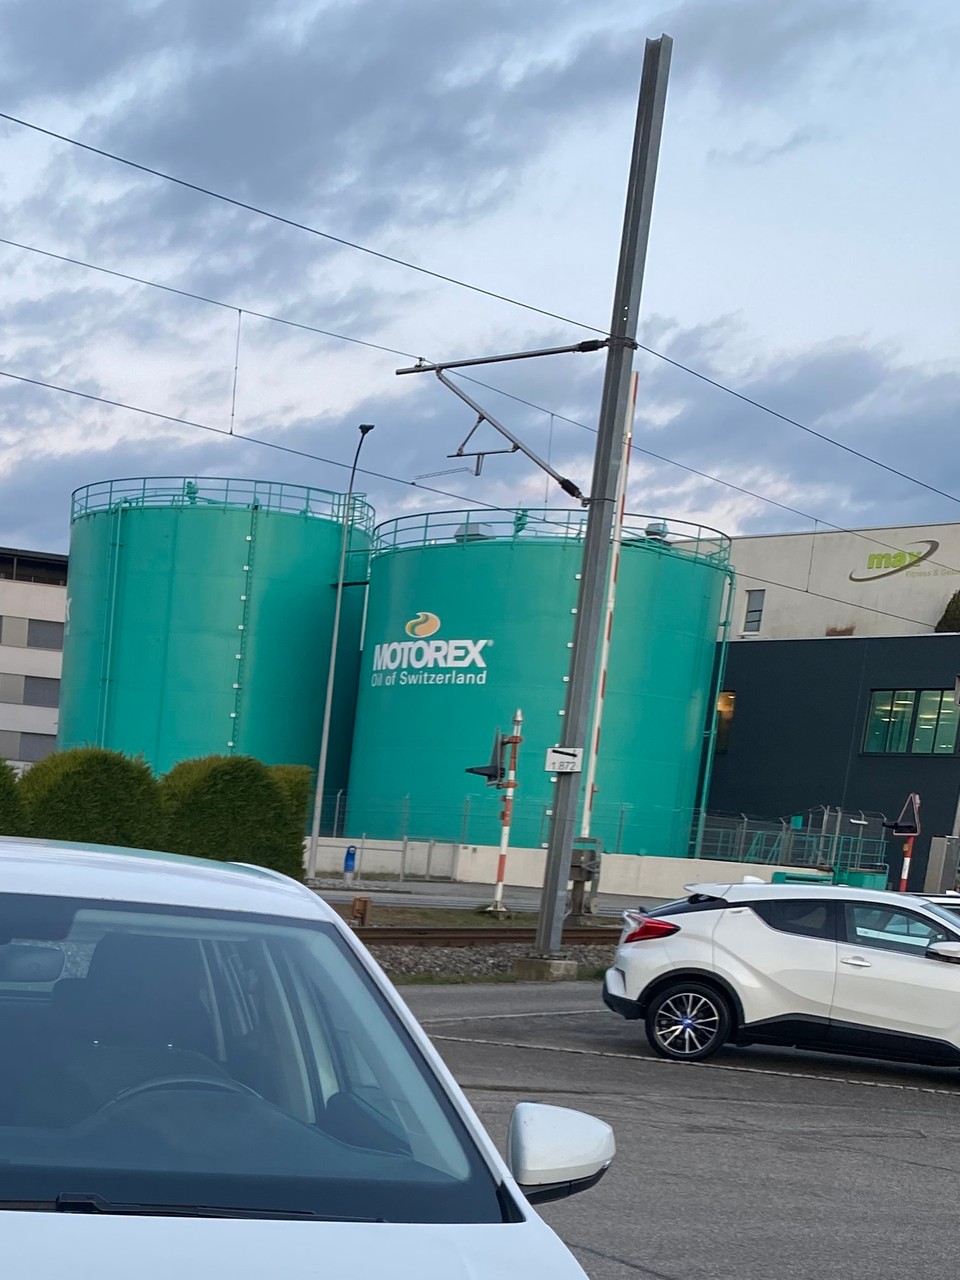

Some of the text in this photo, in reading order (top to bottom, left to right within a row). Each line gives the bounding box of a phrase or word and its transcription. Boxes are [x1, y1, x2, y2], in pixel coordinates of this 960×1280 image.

[371, 669, 487, 687] Oil of Switzerland
[551, 761, 576, 771] 1.872
